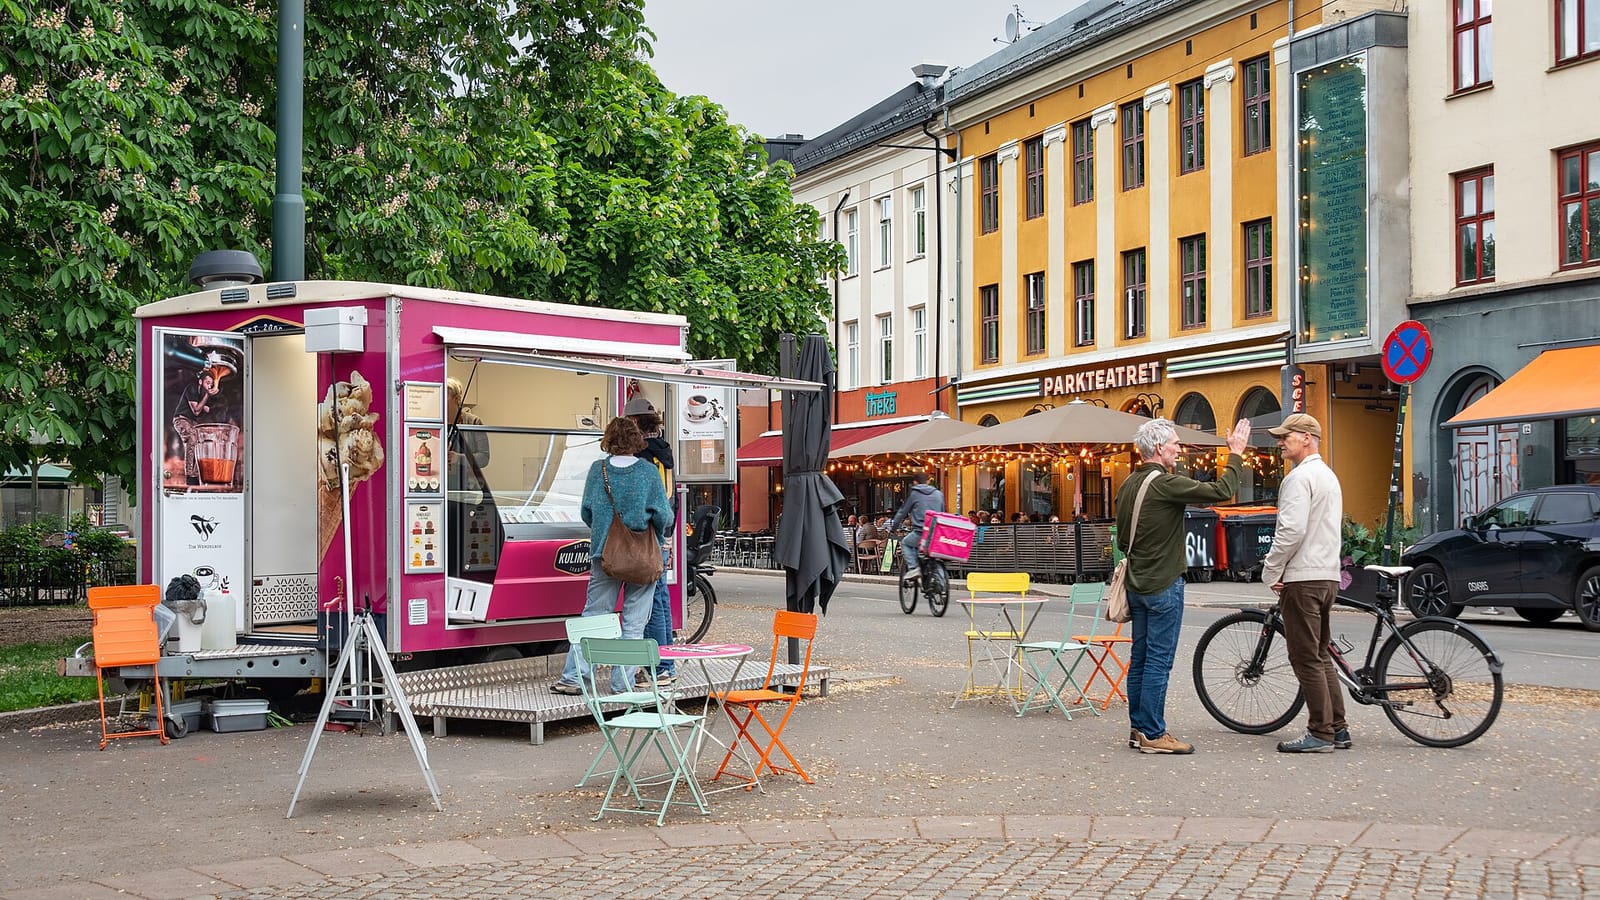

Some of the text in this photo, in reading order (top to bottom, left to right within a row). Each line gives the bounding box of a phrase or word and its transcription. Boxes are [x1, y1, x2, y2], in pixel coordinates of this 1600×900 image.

[1044, 361, 1160, 397] PARKTEATRET
[1292, 374, 1303, 412] SCE
[866, 390, 897, 417] theka
[558, 552, 591, 565] KULINA
